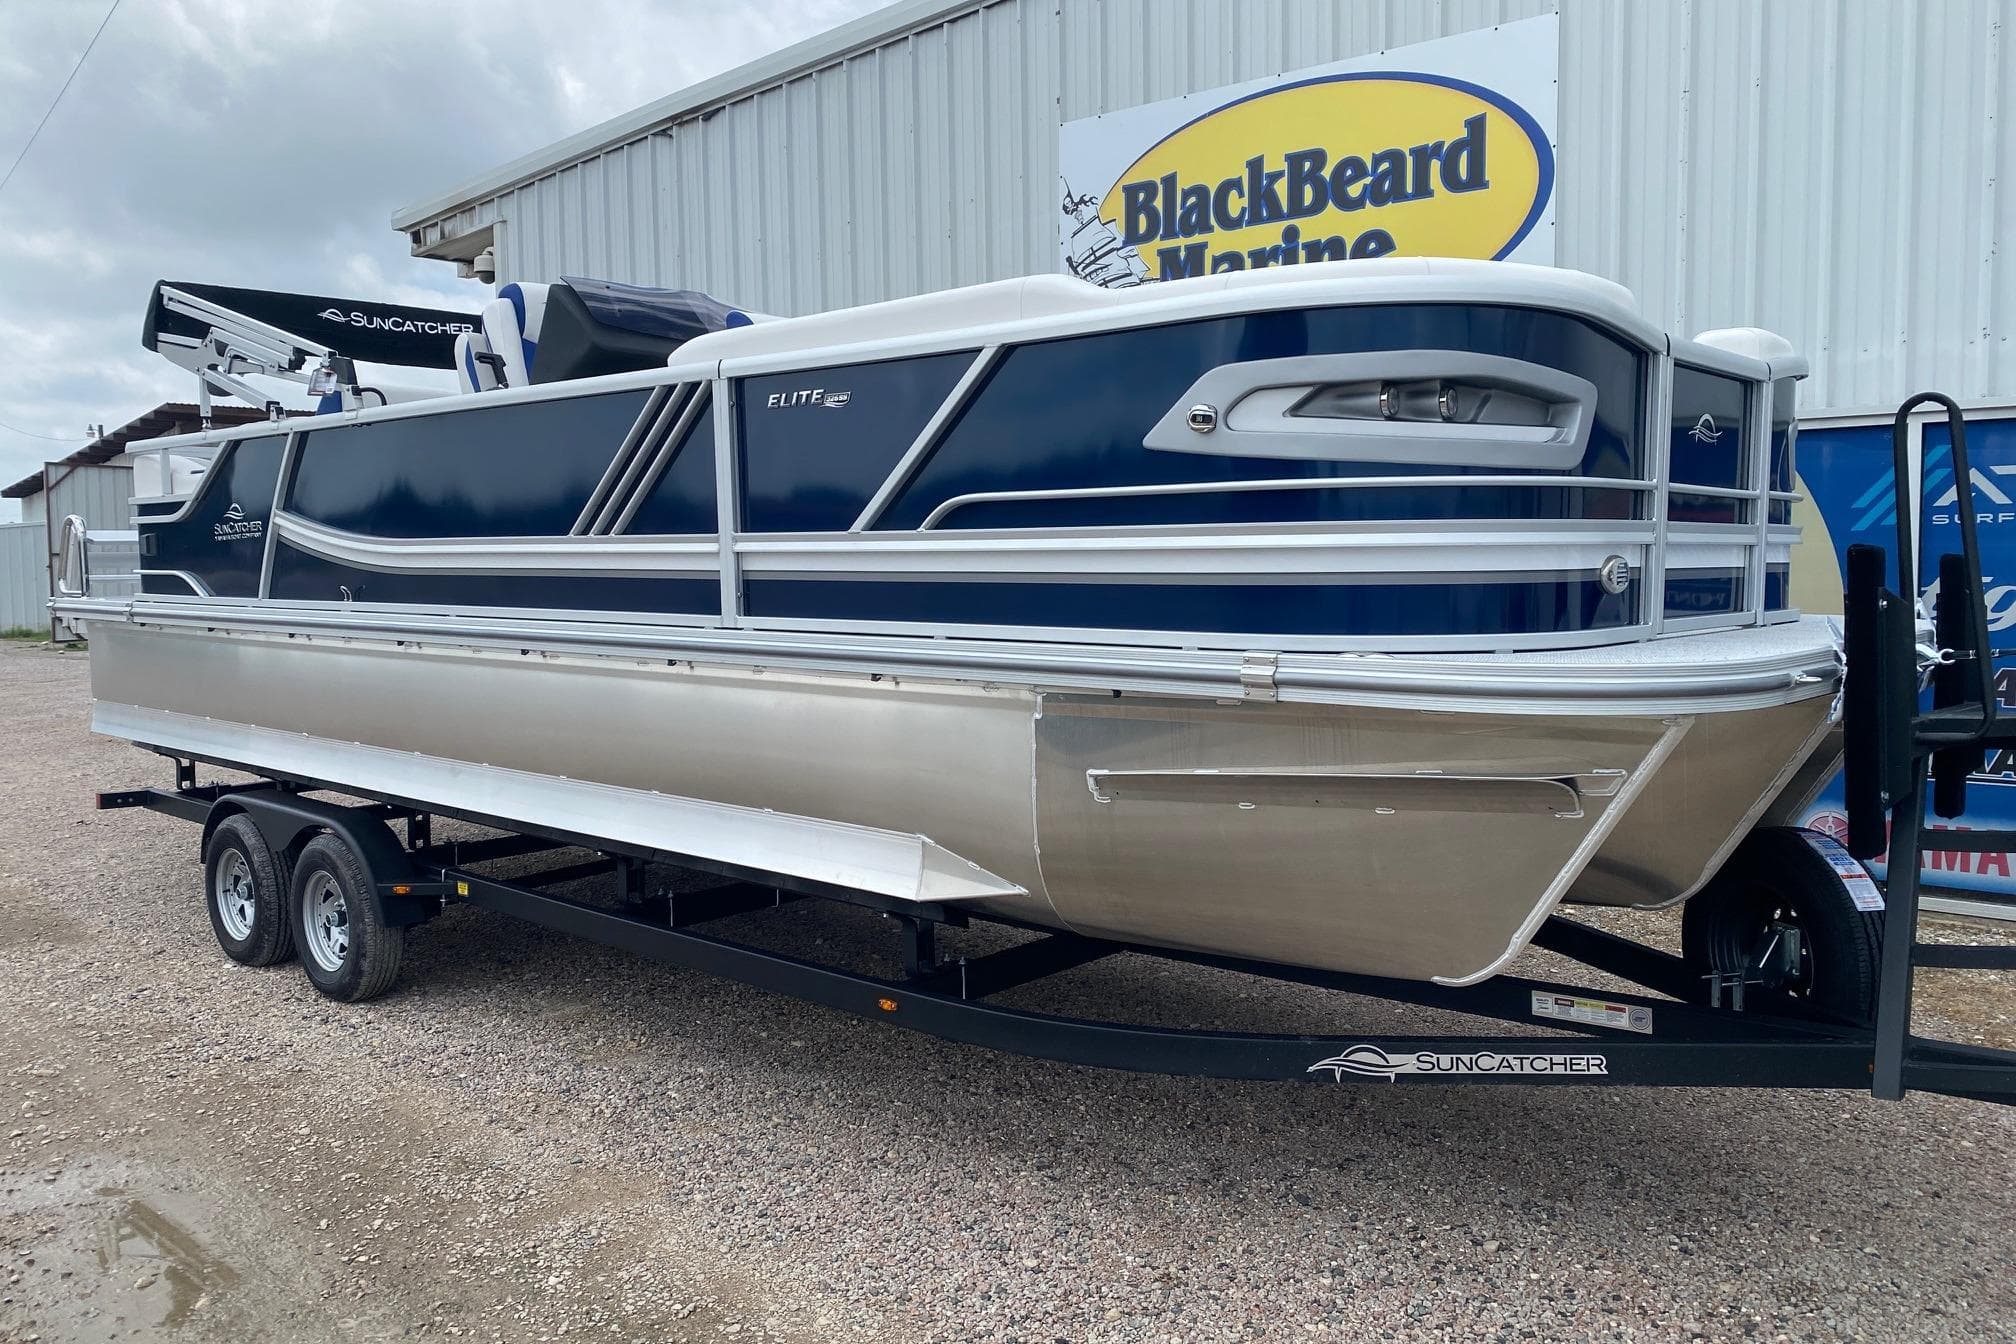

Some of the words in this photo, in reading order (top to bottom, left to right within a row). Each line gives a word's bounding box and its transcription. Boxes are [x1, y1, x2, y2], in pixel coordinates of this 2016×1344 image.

[1121, 111, 1490, 247] BlackBeard
[350, 312, 474, 335] SUNCATCHER
[768, 388, 824, 408] ELITE
[1415, 1051, 1608, 1073] SUNCATCHER
